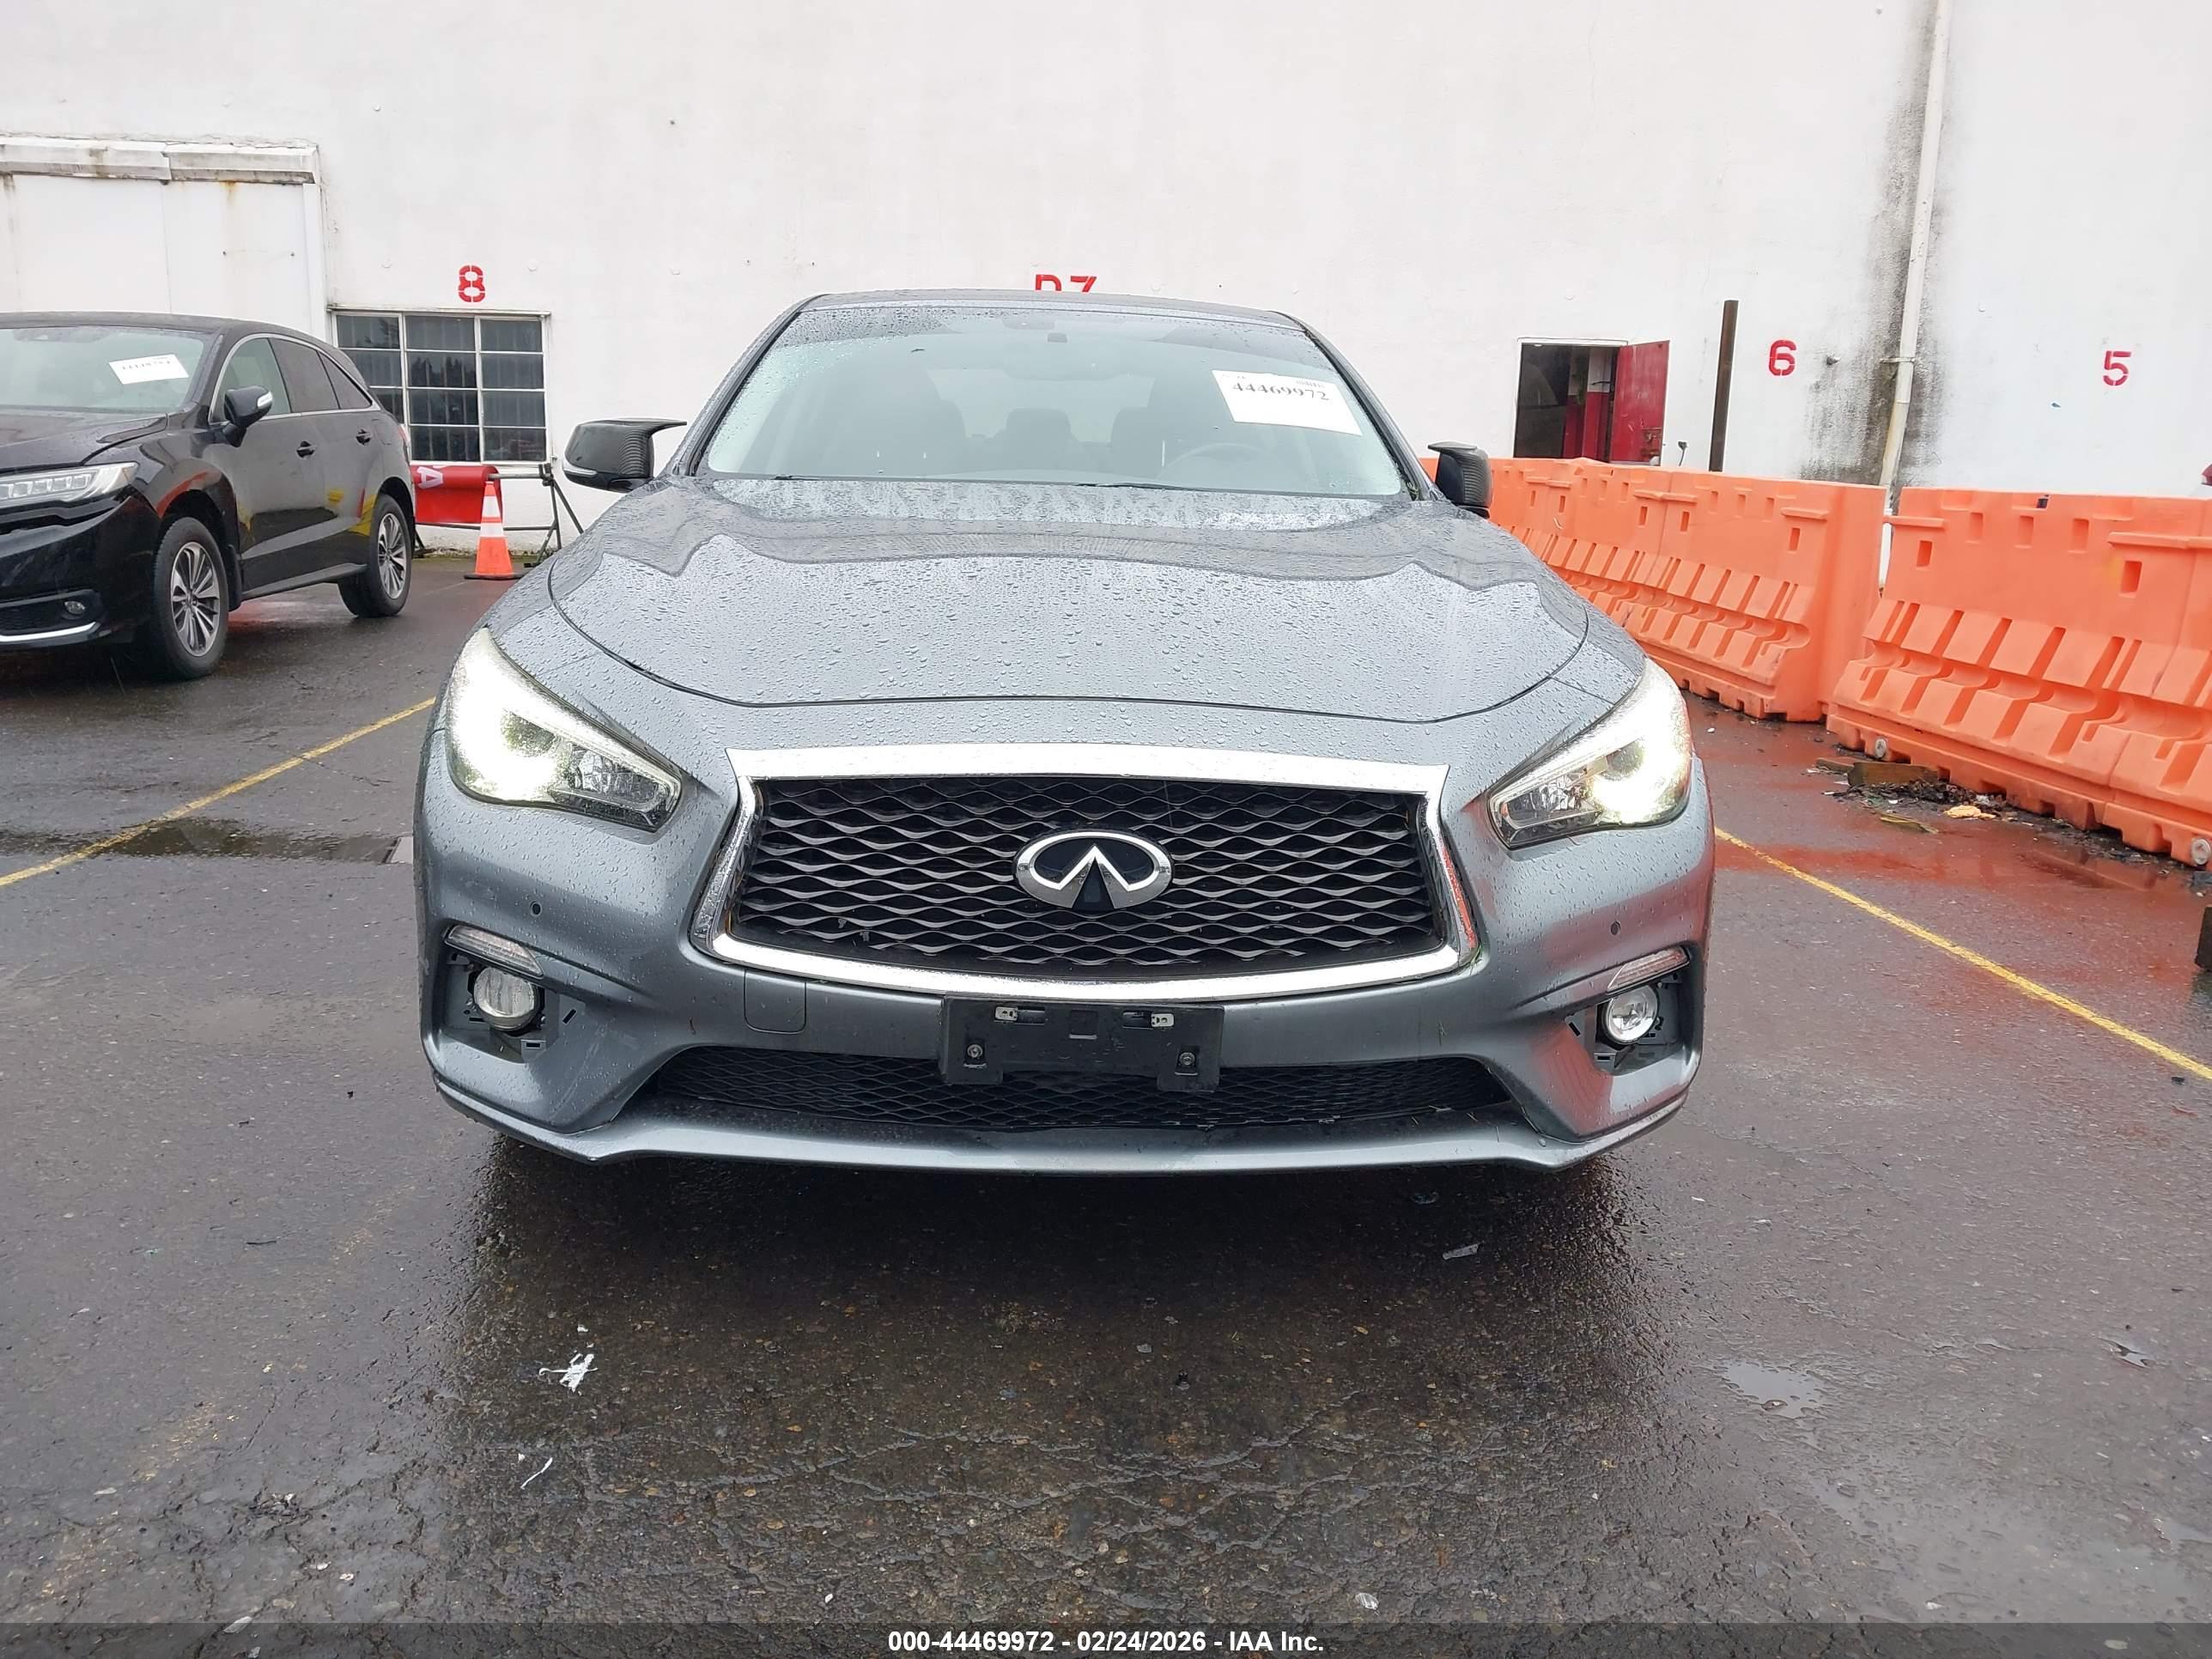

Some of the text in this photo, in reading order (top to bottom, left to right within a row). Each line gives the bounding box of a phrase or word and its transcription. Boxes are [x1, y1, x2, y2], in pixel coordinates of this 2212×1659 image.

[458, 265, 486, 303] 8
[1767, 339, 1797, 377] 6
[2103, 350, 2131, 386] 5
[1232, 382, 1330, 401] 44469972
